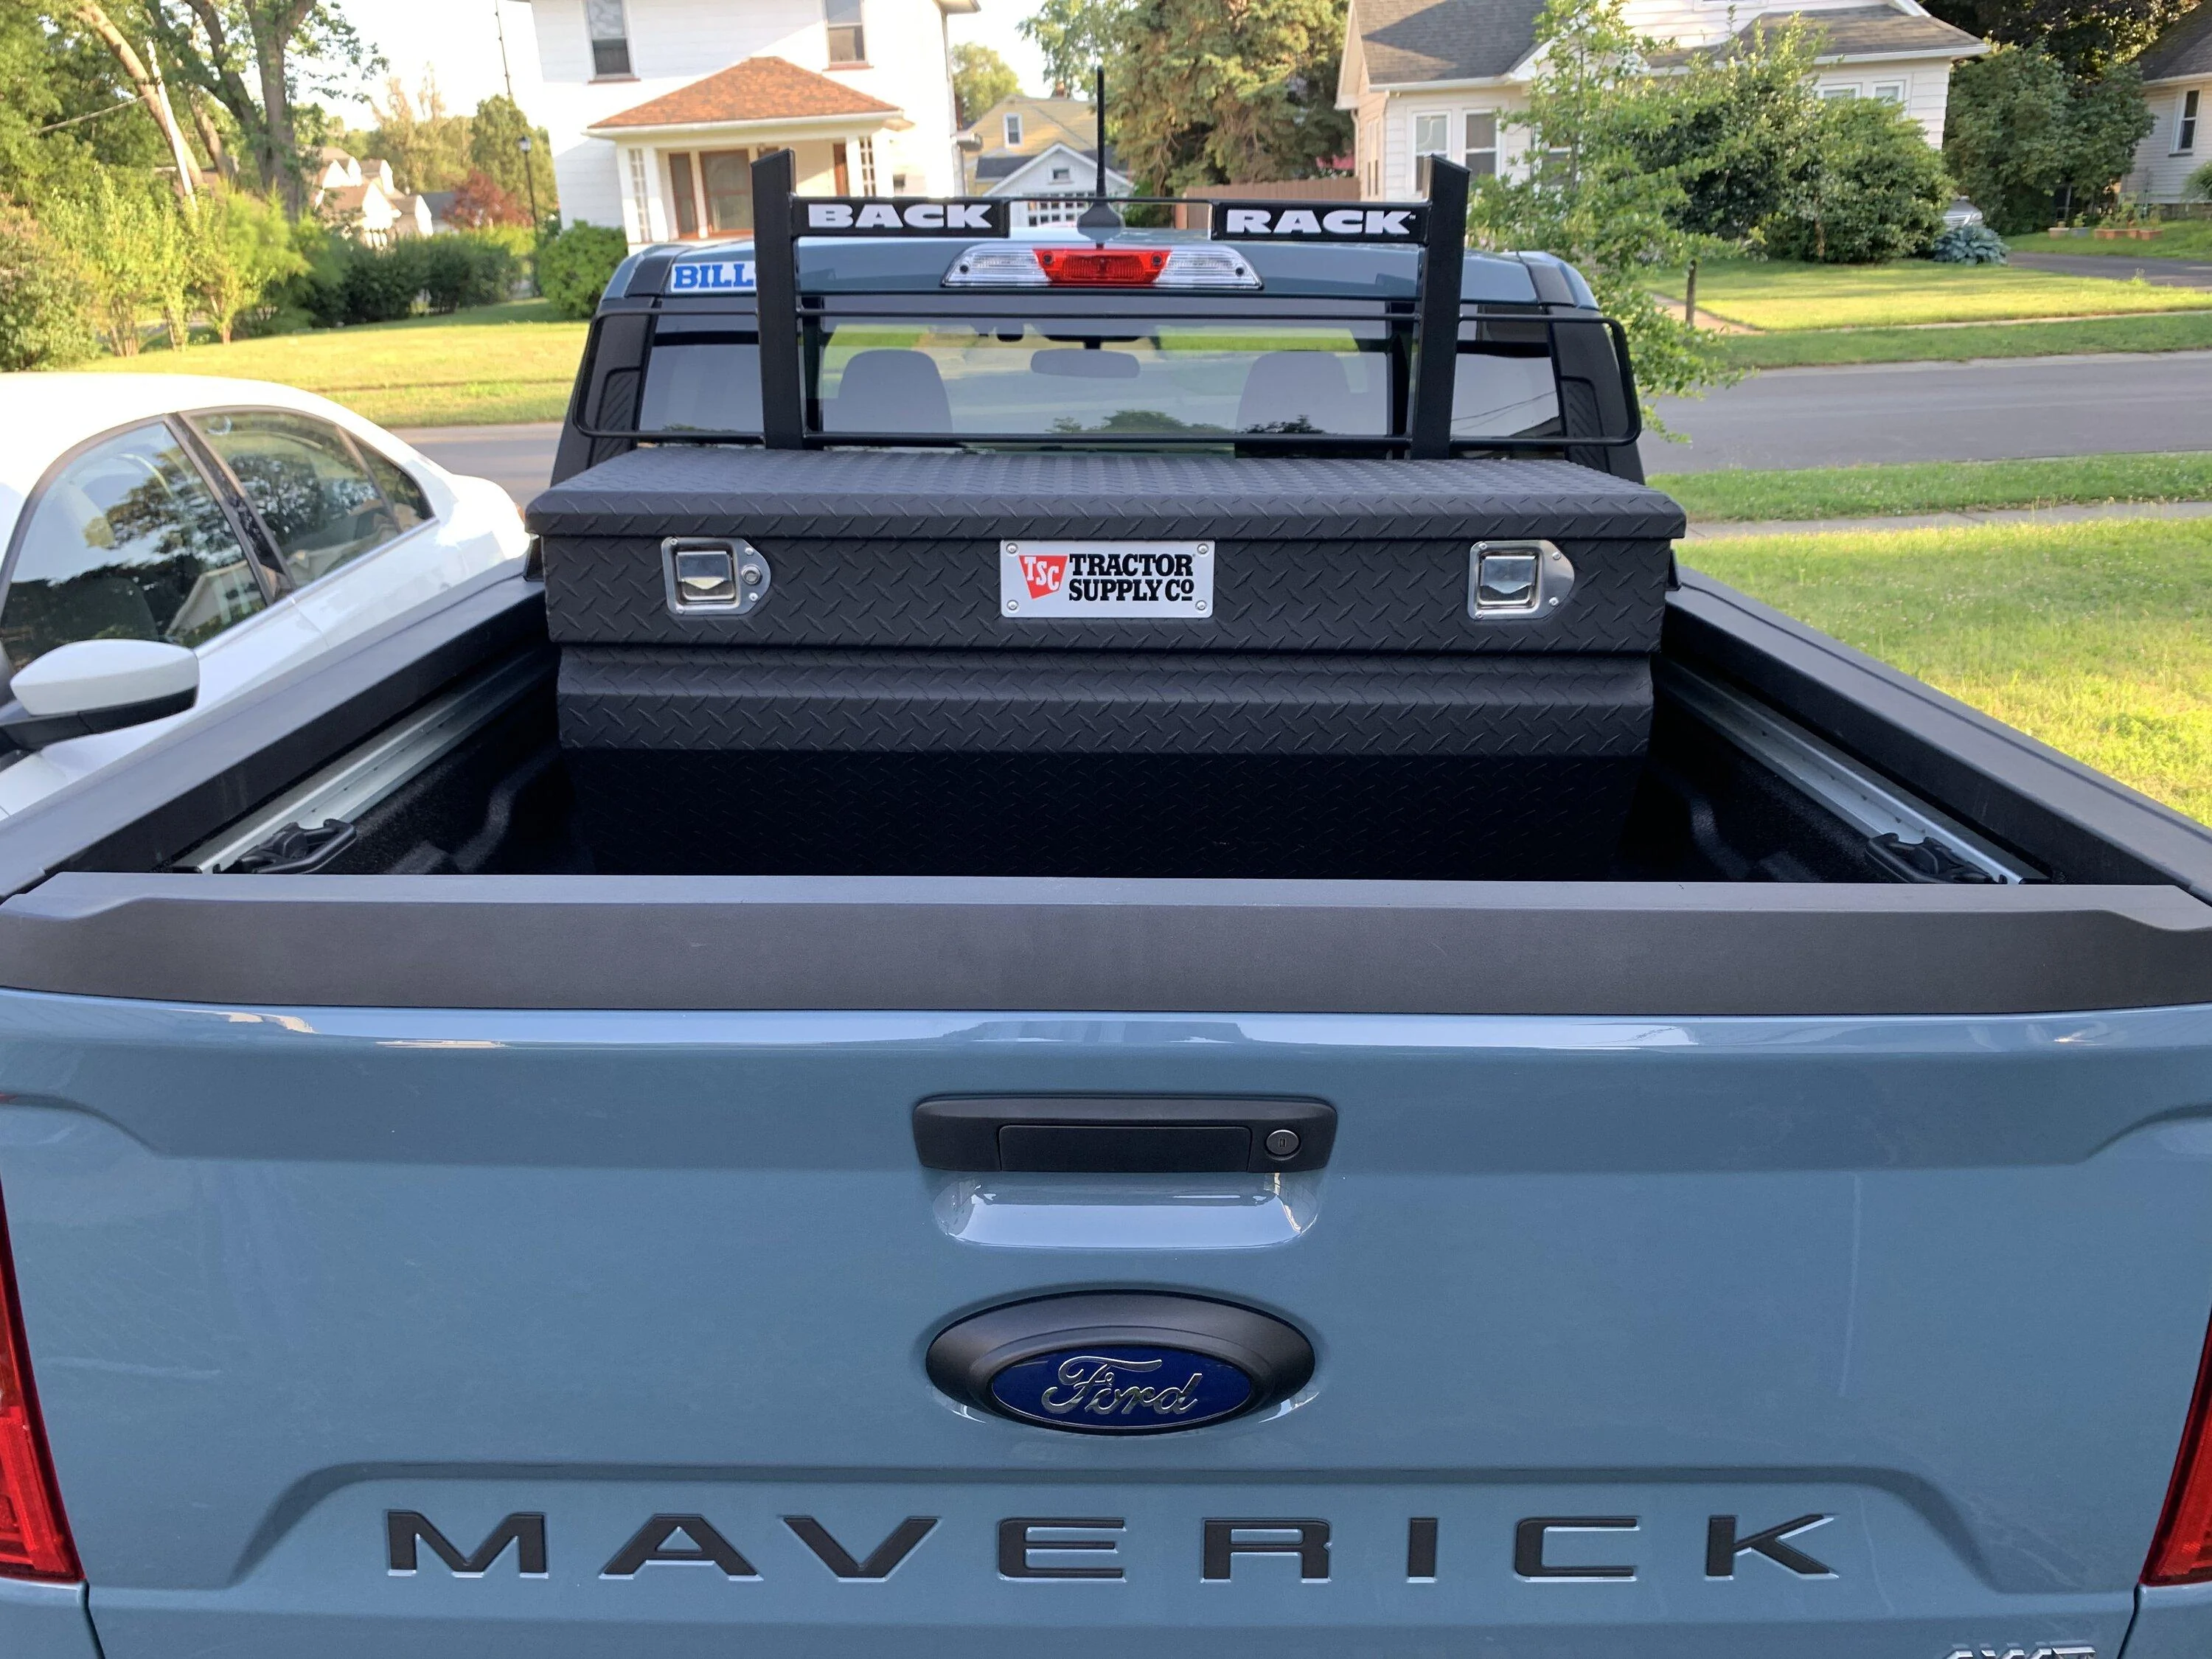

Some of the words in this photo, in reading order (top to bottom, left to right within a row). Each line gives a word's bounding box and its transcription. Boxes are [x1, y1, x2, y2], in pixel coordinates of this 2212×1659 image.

[807, 204, 992, 229] BACK
[1226, 209, 1412, 234] RACK
[673, 263, 756, 289] BILL
[1024, 557, 1059, 591] TSC
[1069, 553, 1193, 577] TRACTOR
[1069, 579, 1163, 602] SUPPLY
[1040, 1354, 1203, 1415] Ford
[386, 1510, 1840, 1583] MAVERICK
